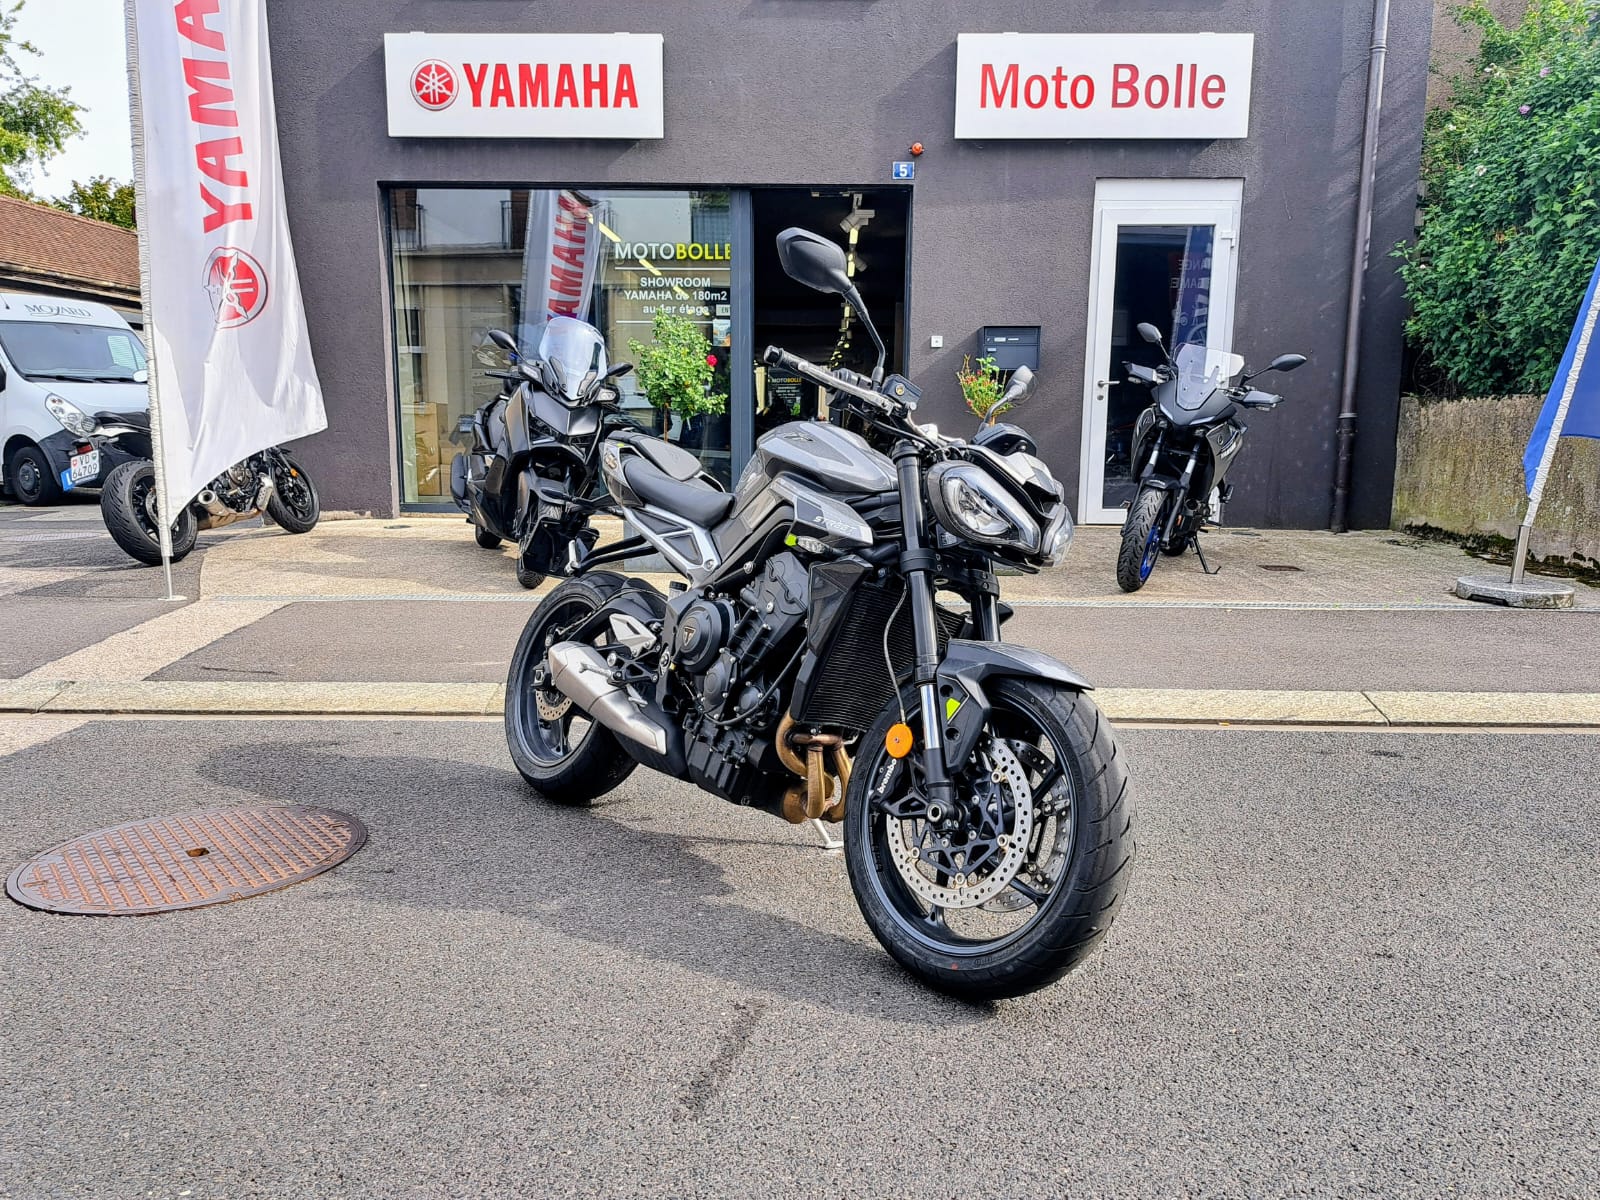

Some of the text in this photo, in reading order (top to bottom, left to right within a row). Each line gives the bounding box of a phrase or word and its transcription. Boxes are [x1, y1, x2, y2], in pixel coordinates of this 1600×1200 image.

[463, 63, 639, 109] YAMAHA
[979, 63, 1226, 109] Moto Bolle
[899, 164, 908, 177] 5
[640, 277, 711, 288] SHOWROOM
[624, 290, 673, 301] YAMAHA
[692, 290, 728, 301] 180m2
[643, 304, 709, 316] au 1er étage
[80, 454, 90, 466] VD
[72, 463, 98, 479] 64709
[876, 758, 897, 794] brembo
